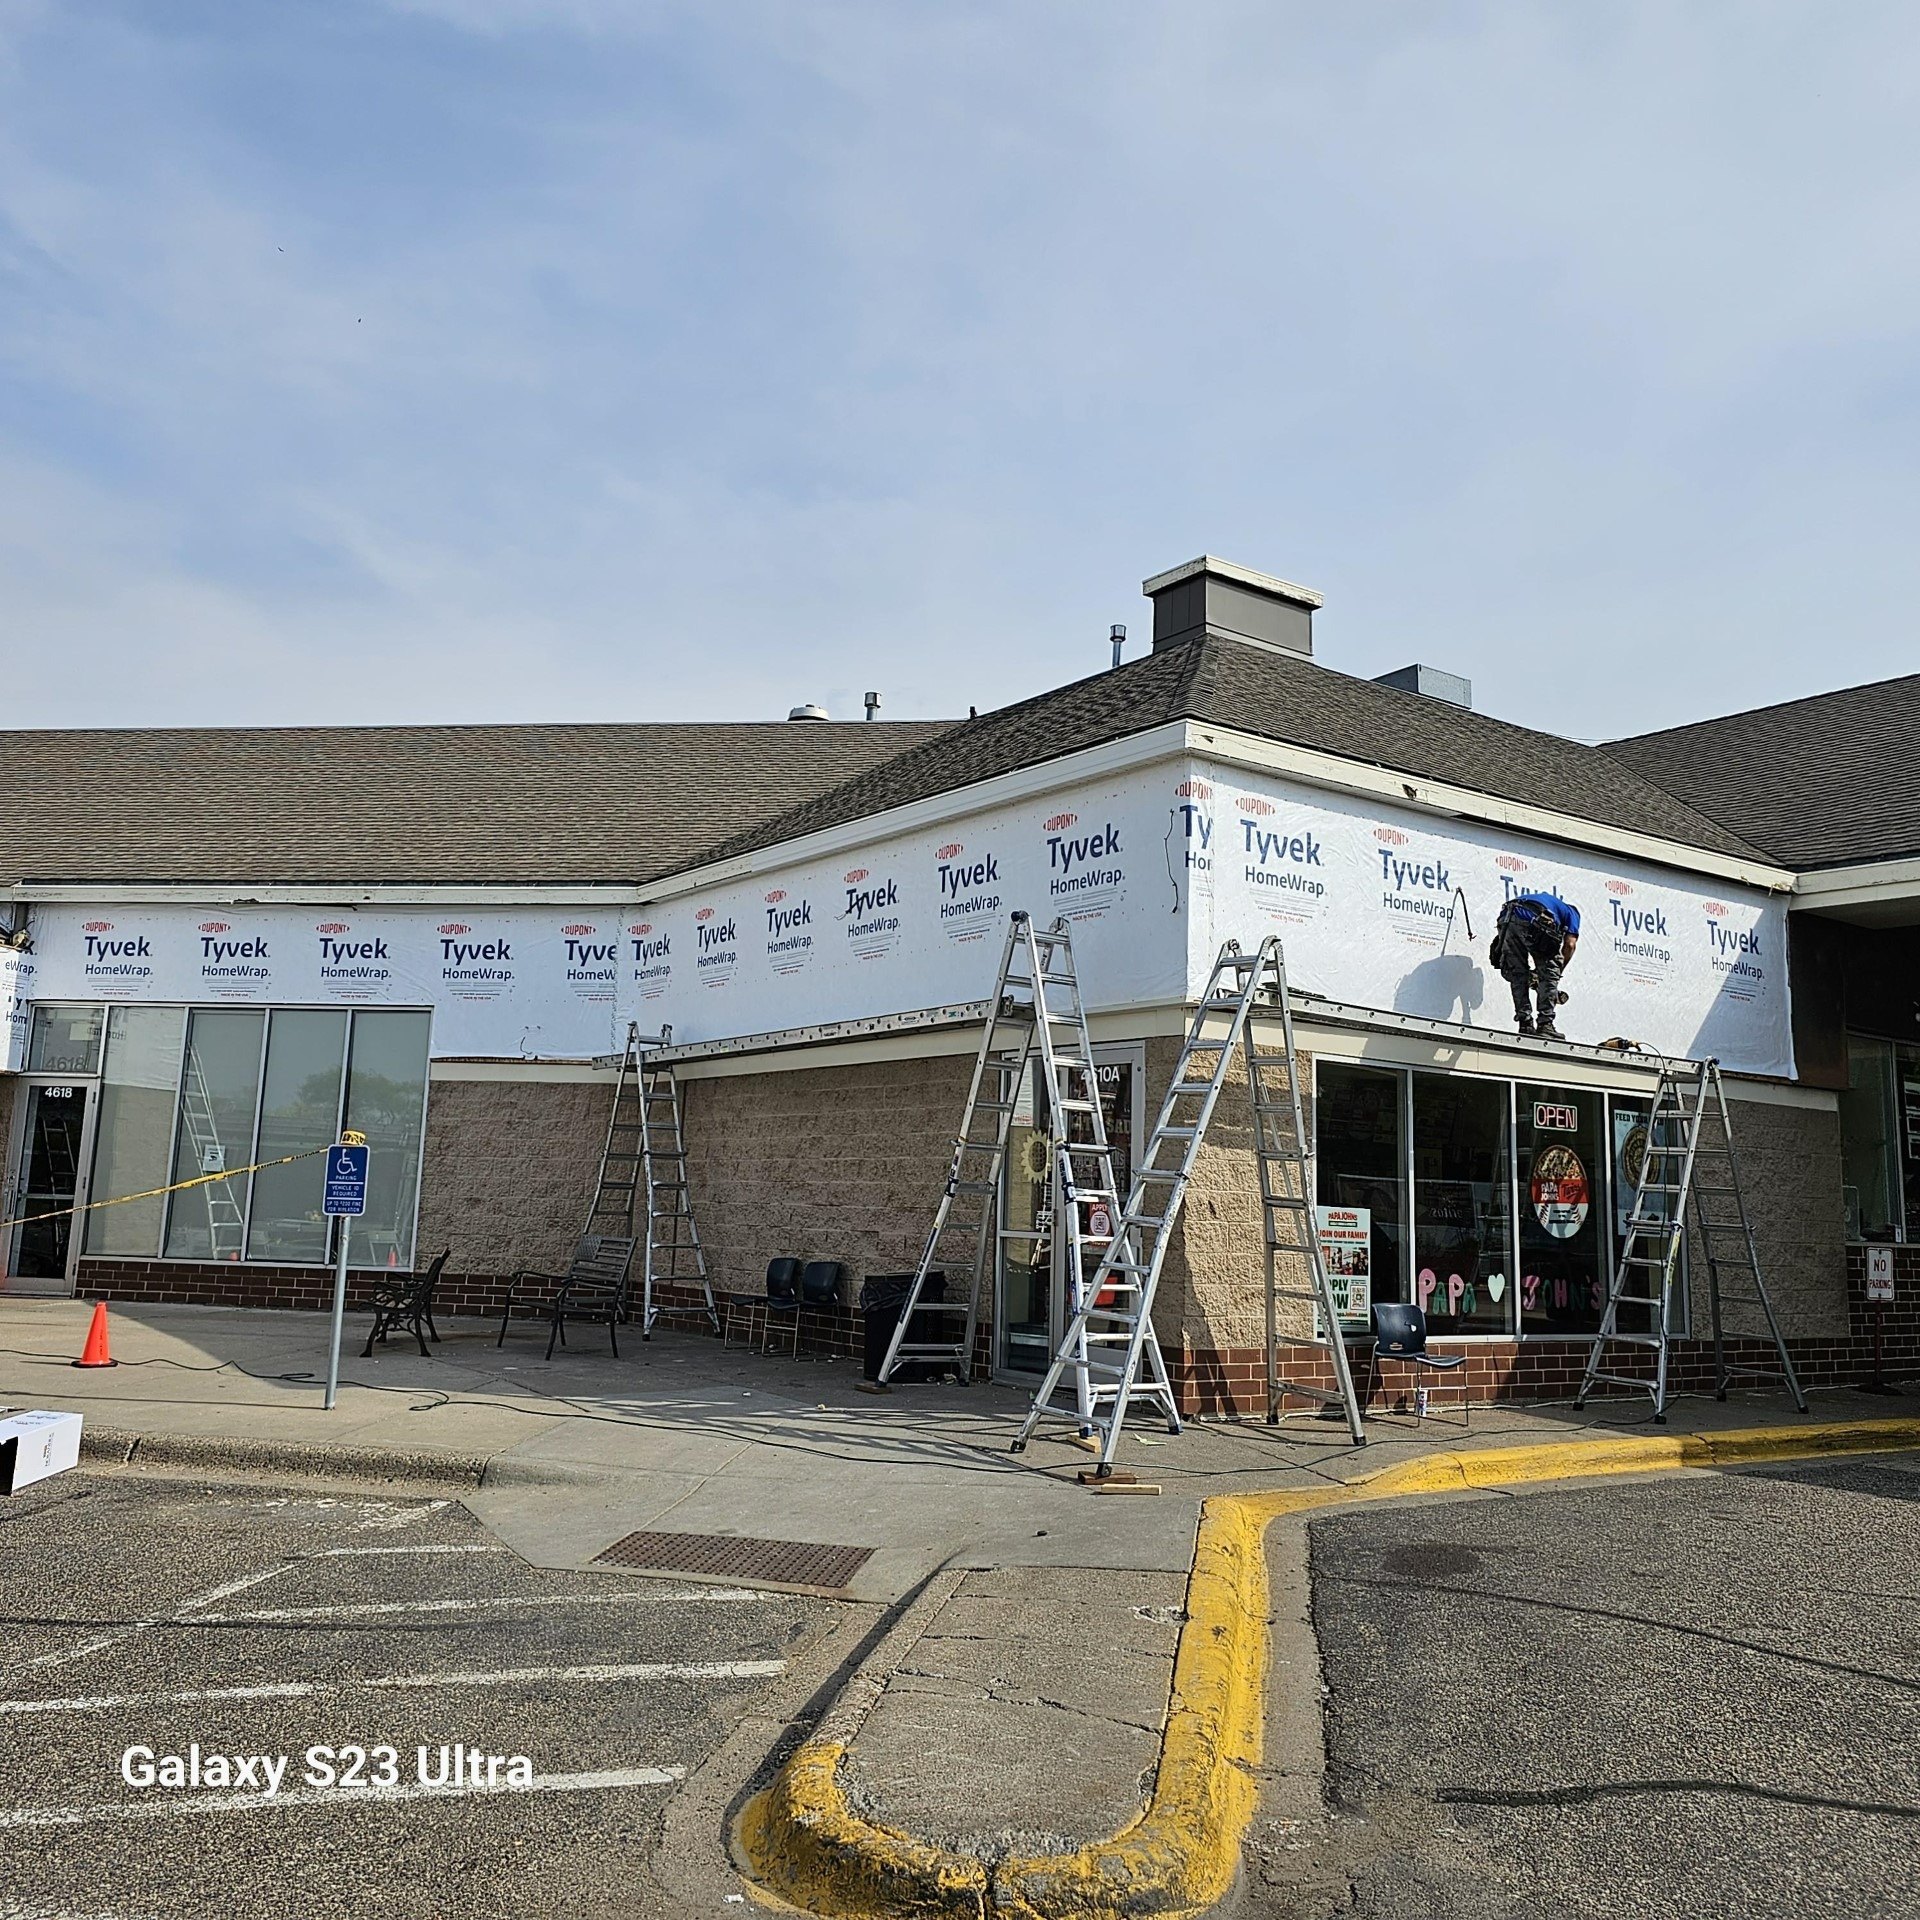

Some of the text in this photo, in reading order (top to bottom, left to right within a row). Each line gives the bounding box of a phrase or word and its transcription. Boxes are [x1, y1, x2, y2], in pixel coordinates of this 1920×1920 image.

[1240, 798, 1271, 816] DUPONT
[1047, 814, 1074, 831] DUPONT
[1180, 804, 1211, 849] Ty
[1240, 819, 1320, 866] Tyvek
[1378, 828, 1405, 846] DUPONT
[938, 844, 960, 859] DUPONT
[1046, 823, 1120, 873] Tyvek
[1378, 849, 1450, 892] Tyvek
[1500, 856, 1524, 872] DUPONT
[846, 869, 866, 883] DUPONT
[938, 854, 998, 898] Tyvek
[1050, 869, 1122, 895] HomeWrap
[1246, 865, 1324, 898] HomeWrap
[1608, 880, 1630, 895] DUPONT
[768, 890, 784, 903] DUPONT
[846, 878, 898, 920] Tyvek
[697, 908, 712, 920] DUPONT
[940, 895, 1000, 918] HomeWrap
[1384, 892, 1453, 922] HomeWrap
[1706, 902, 1726, 916] DUPONT
[767, 900, 811, 937] Tyvek
[1609, 898, 1667, 936] Tyvek
[86, 922, 111, 932] DUPONT
[202, 922, 228, 932] DUPONT
[320, 923, 346, 934] DUPONT
[440, 924, 468, 934] DUPONT
[565, 925, 592, 935] DUPONT
[697, 918, 736, 952] Tyvek
[848, 916, 898, 938] HomeWrap
[768, 935, 812, 954] HomeWrap
[1706, 920, 1760, 956] Tyvek
[84, 936, 150, 962] Tyvek
[200, 937, 268, 963] Tyvek
[320, 938, 388, 964] Tyvek
[440, 939, 510, 966] Tyvek
[632, 933, 670, 966] Tyvek
[1614, 938, 1670, 962] HomeWrap
[697, 951, 736, 968] HomeWrap
[85, 964, 150, 977] HomeWrap
[202, 966, 269, 978] HomeWrap
[321, 966, 389, 980] HomeWrap
[442, 968, 512, 981] HomeWrap
[634, 966, 670, 980] HomeWrap
[1712, 957, 1762, 981] HomeWrap
[46, 1056, 85, 1071] 4618
[45, 1086, 72, 1098] 4618
[1536, 1105, 1575, 1129] OPEN
[1616, 1113, 1630, 1122] FEED
[1541, 1182, 1558, 1193] PAPA
[1541, 1193, 1559, 1201] JOHNS
[1319, 1230, 1332, 1238] JOIN
[1334, 1230, 1346, 1238] OUR
[1874, 1258, 1886, 1272] NO
[1418, 1268, 1476, 1316] PAPA
[1869, 1279, 1891, 1289] PARKING
